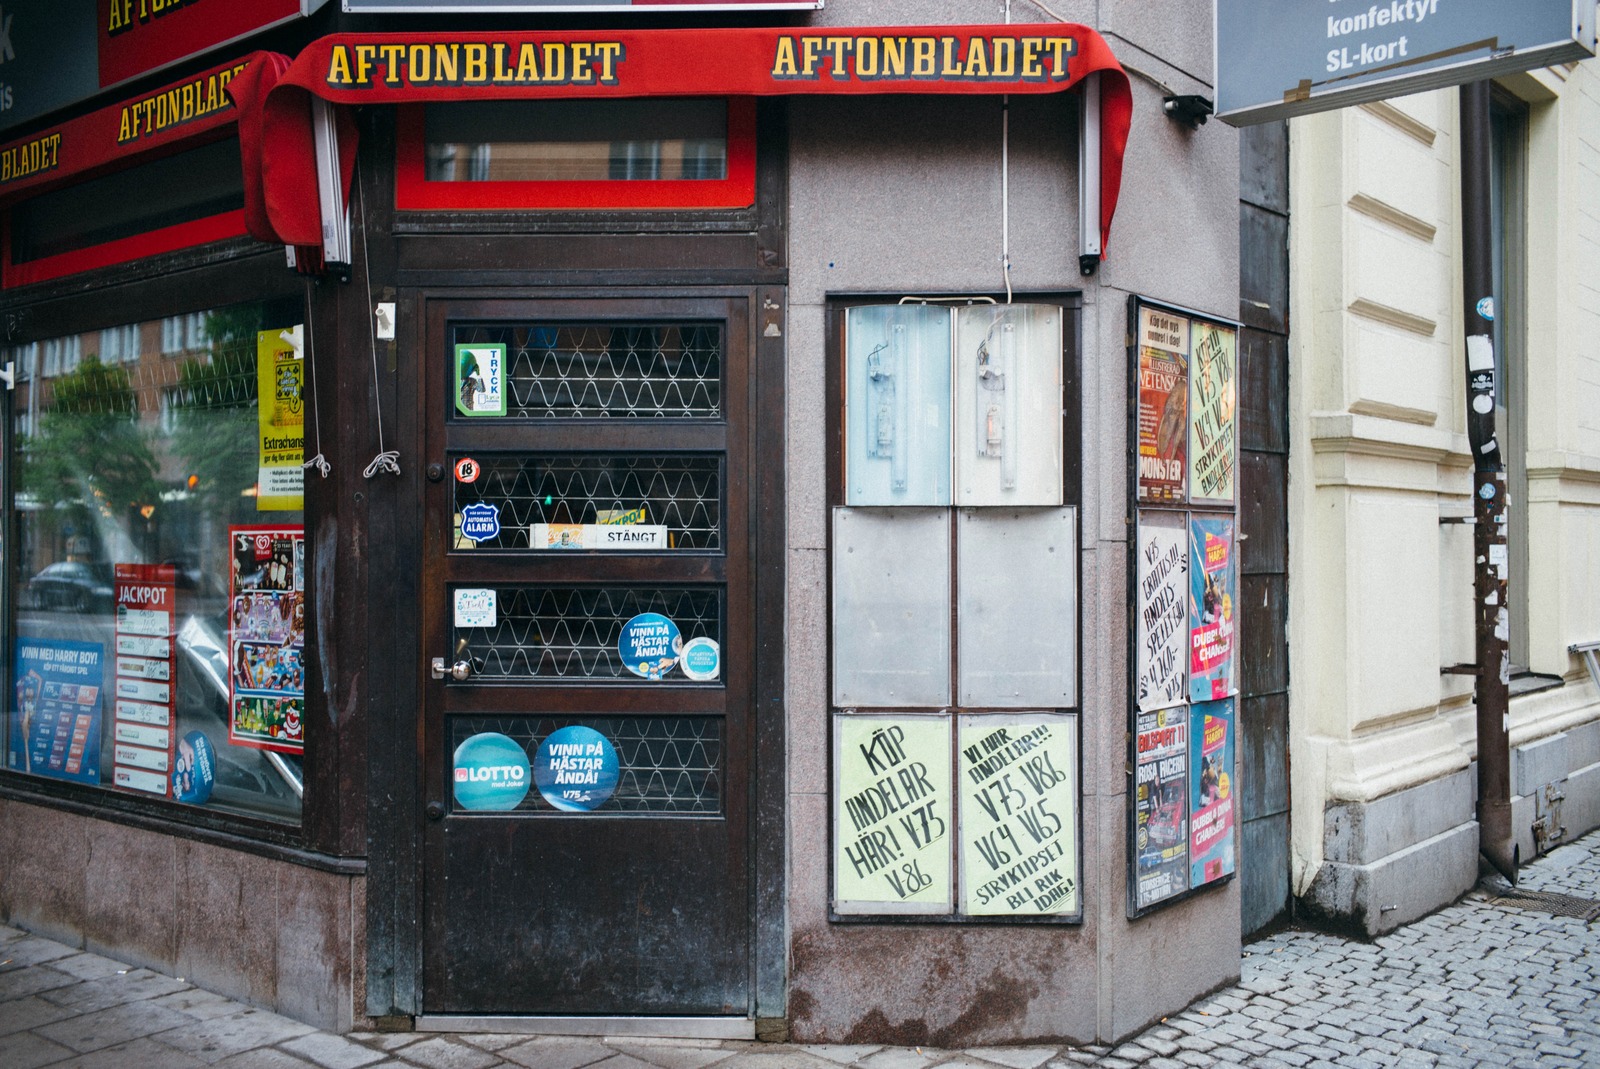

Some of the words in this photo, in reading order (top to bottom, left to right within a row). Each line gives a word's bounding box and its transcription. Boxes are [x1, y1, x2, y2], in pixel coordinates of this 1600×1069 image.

[1327, 0, 1439, 38] konfektyr
[327, 42, 622, 86] AFTONBLADET
[772, 37, 1074, 79] AFTONBLADET
[1326, 35, 1409, 73] SL-kort
[490, 350, 498, 394] TRYCK
[1148, 358, 1181, 375] ILLUSTRERAD
[462, 463, 473, 476] 18
[1140, 456, 1181, 481] MONSTER
[466, 523, 494, 532] ALARM
[607, 529, 657, 542] STÄNGT
[1145, 536, 1159, 565] V75
[1142, 543, 1179, 600] GRATTIS!!!
[118, 586, 167, 604] JACKPOT
[630, 627, 654, 637] VINN
[656, 624, 669, 636] PÅ
[631, 634, 669, 647] HÄSTAR
[22, 646, 38, 660] VINN
[39, 648, 54, 661] MED
[54, 649, 78, 663] HARRY
[80, 650, 98, 665] BOY!
[635, 644, 666, 657] ÄNDÅ!
[1206, 726, 1224, 746] HARRY
[549, 744, 585, 756] VINN
[586, 741, 604, 756] PÅ
[860, 725, 907, 776] KÖP
[963, 744, 982, 764] VI
[968, 724, 1052, 785] ANDELAR!!!
[550, 756, 603, 770] HÄSTAR
[470, 766, 524, 782] LOTTO
[506, 780, 524, 788] Joker
[555, 770, 598, 784] ÄNDÅ!
[1138, 765, 1157, 784] ROSA
[563, 790, 581, 798] V75
[974, 773, 1026, 822] V75
[1018, 750, 1067, 796] V86
[844, 762, 936, 832] ANDELAR
[974, 824, 1022, 871] V64
[1016, 798, 1062, 844] V65
[844, 824, 904, 879] HÄR!
[976, 838, 1064, 906] STRYKTIPSET
[1006, 886, 1034, 910] BLI
[1034, 868, 1064, 894] RIK
[1034, 878, 1076, 912] IDAG!
